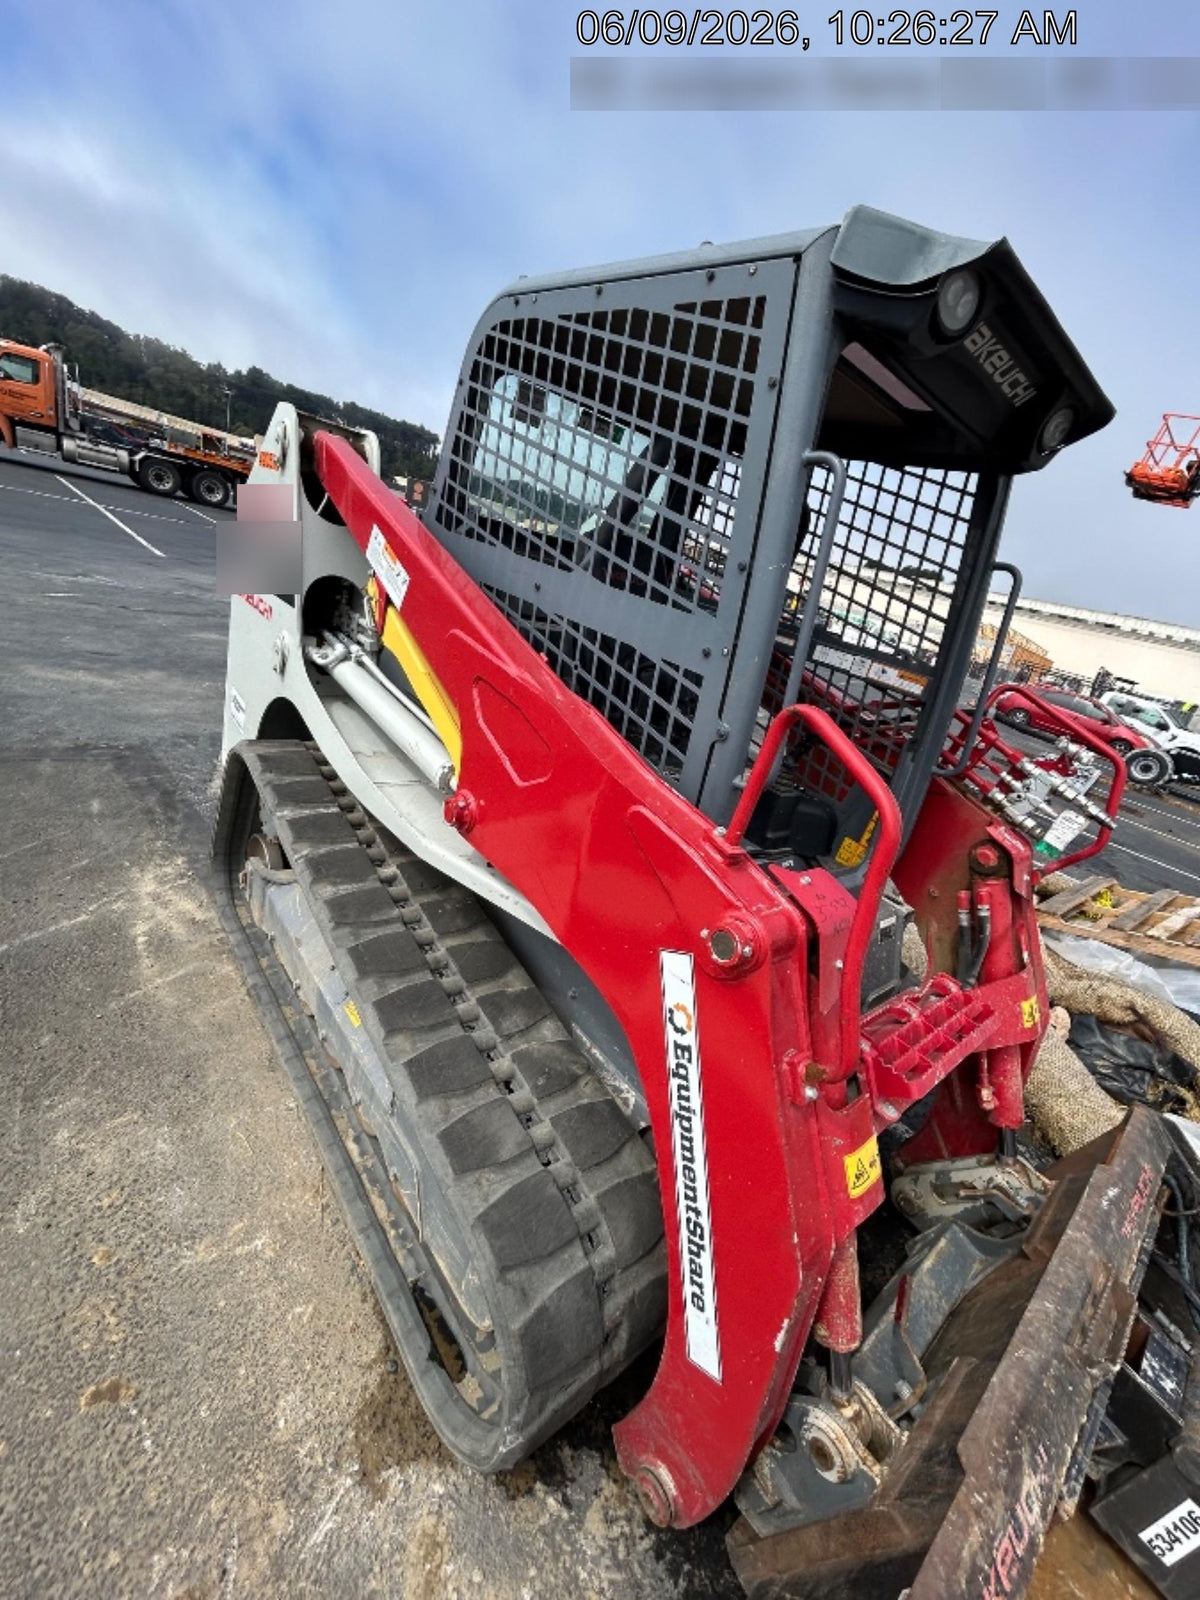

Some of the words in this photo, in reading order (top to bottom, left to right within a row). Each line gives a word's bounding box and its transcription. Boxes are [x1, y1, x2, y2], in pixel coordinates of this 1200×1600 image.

[963, 321, 1037, 408] AKEUCHI
[671, 1039, 706, 1314] EquipmentShare
[1146, 1510, 1200, 1558] 534106
